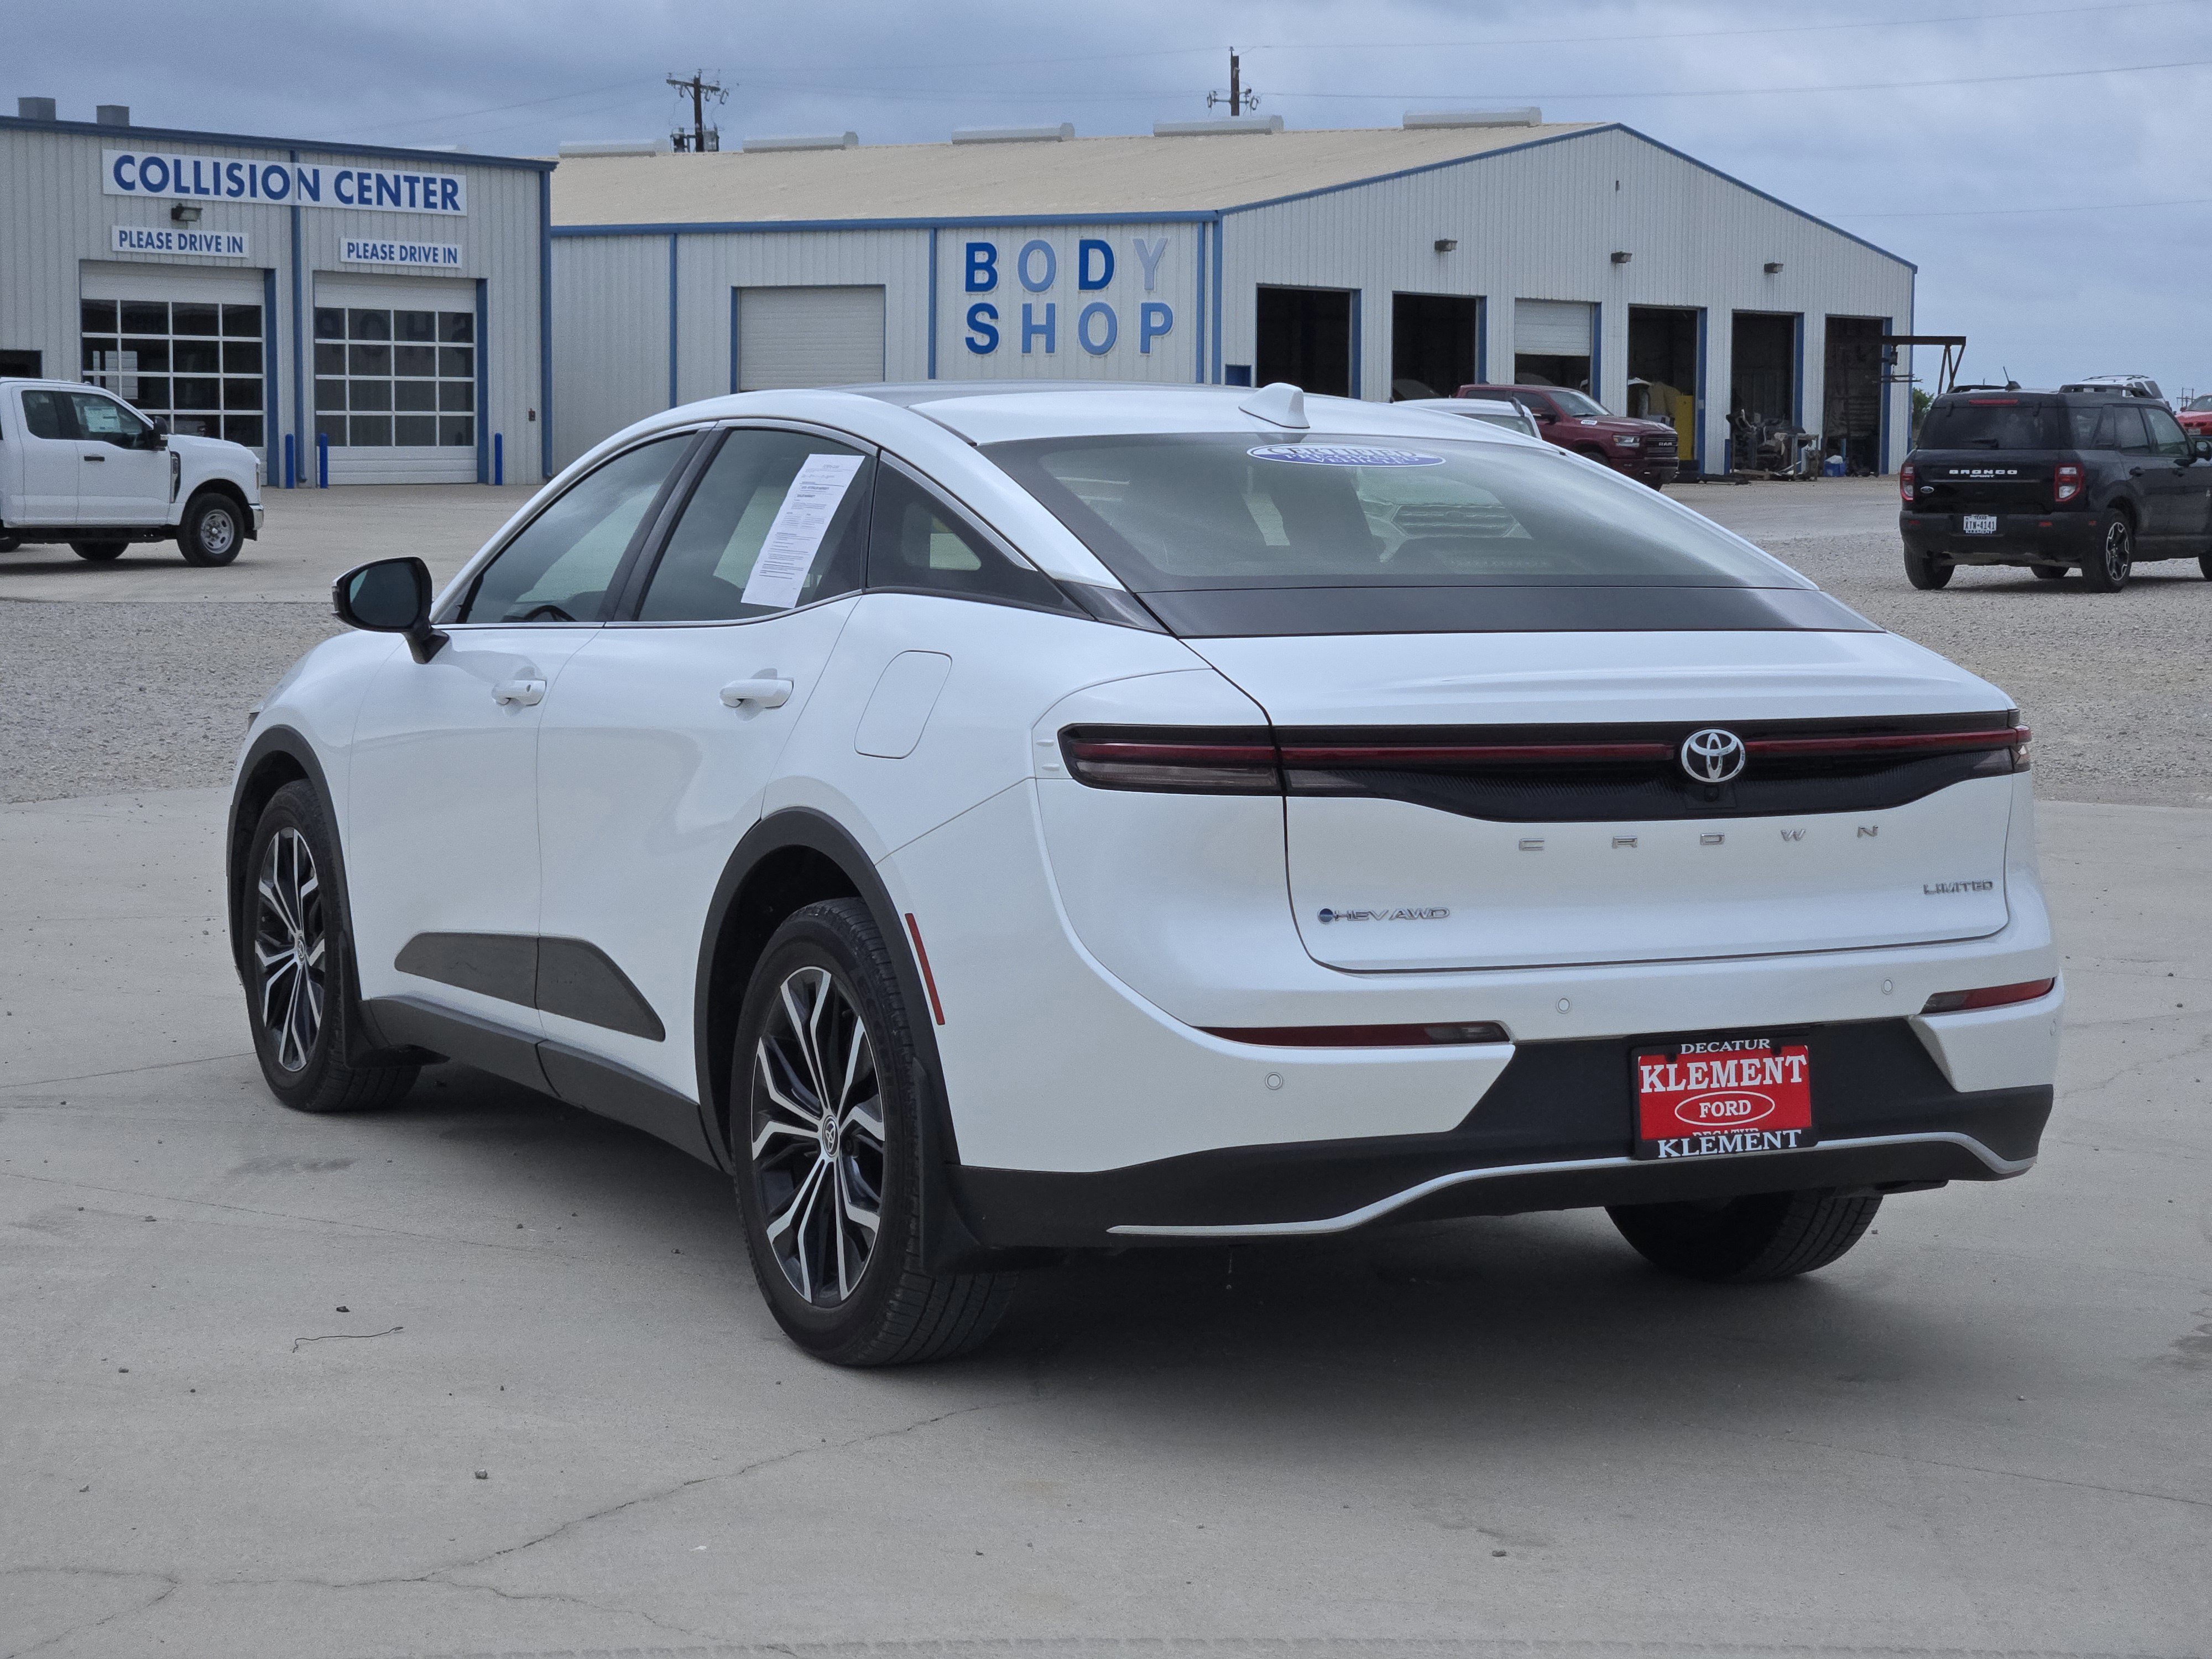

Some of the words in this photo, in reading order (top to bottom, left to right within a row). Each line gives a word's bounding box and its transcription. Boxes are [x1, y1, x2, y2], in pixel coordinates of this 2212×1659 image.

[113, 155, 320, 202] COLLISION
[334, 170, 461, 211] CENTER
[118, 230, 173, 250] PLEASE
[178, 233, 222, 252] DRIVE
[227, 236, 243, 253] IN
[347, 242, 395, 261] PLEASE
[399, 244, 439, 263] DRIVE
[443, 247, 457, 264] IN
[965, 238, 1168, 292] BODY
[966, 302, 1173, 355] SHOP
[1267, 447, 1418, 457] CERTIFIED
[1518, 825, 1879, 851] CROWN
[1923, 880, 1993, 895] LIMITED
[1681, 1039, 1771, 1055] DECATUR
[1640, 1055, 1808, 1093] KLEMENT
[1699, 1099, 1751, 1119] FORD
[1657, 1130, 1802, 1159] KLEMENT
